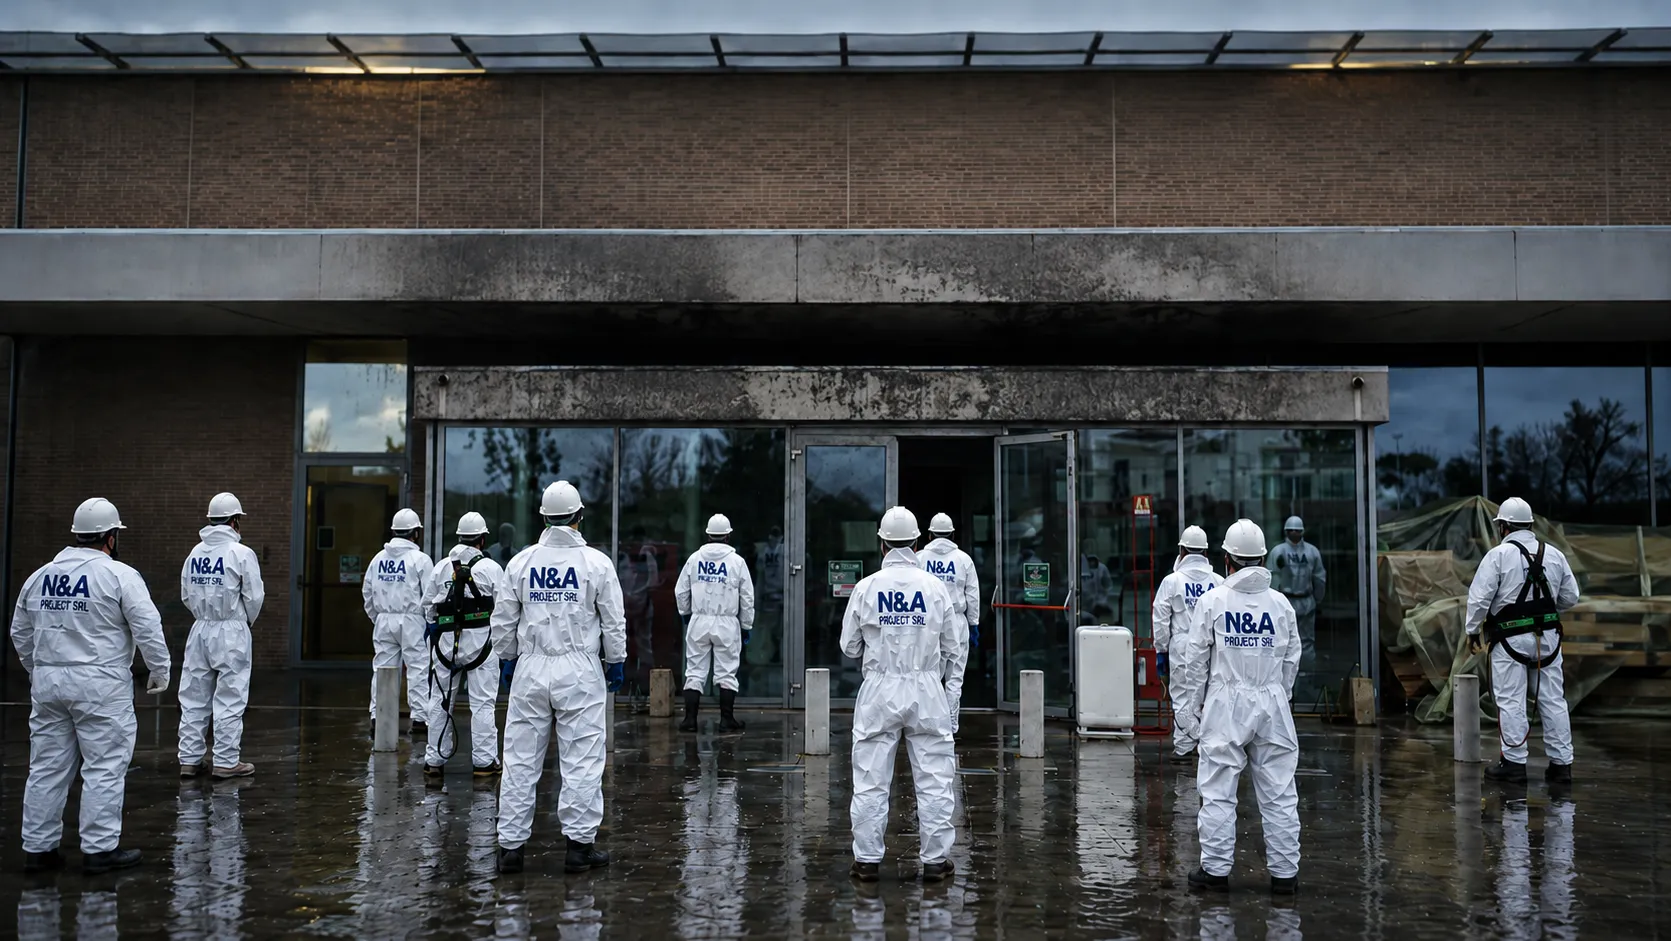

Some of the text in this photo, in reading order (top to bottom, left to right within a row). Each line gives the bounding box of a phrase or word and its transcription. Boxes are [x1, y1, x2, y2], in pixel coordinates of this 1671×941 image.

[191, 557, 225, 575] N&A
[378, 560, 406, 574] N&A
[698, 561, 728, 577] N&A
[926, 560, 956, 575] N&A
[530, 567, 579, 589] N&A
[41, 574, 90, 598] N&A
[530, 591, 563, 602] PROJECT
[878, 591, 927, 613] N&A
[40, 599, 89, 612] PROJECT SRL
[879, 615, 926, 625] PROJECT SRL
[1225, 611, 1275, 635] N&A
[1224, 636, 1259, 647] PROJECT
